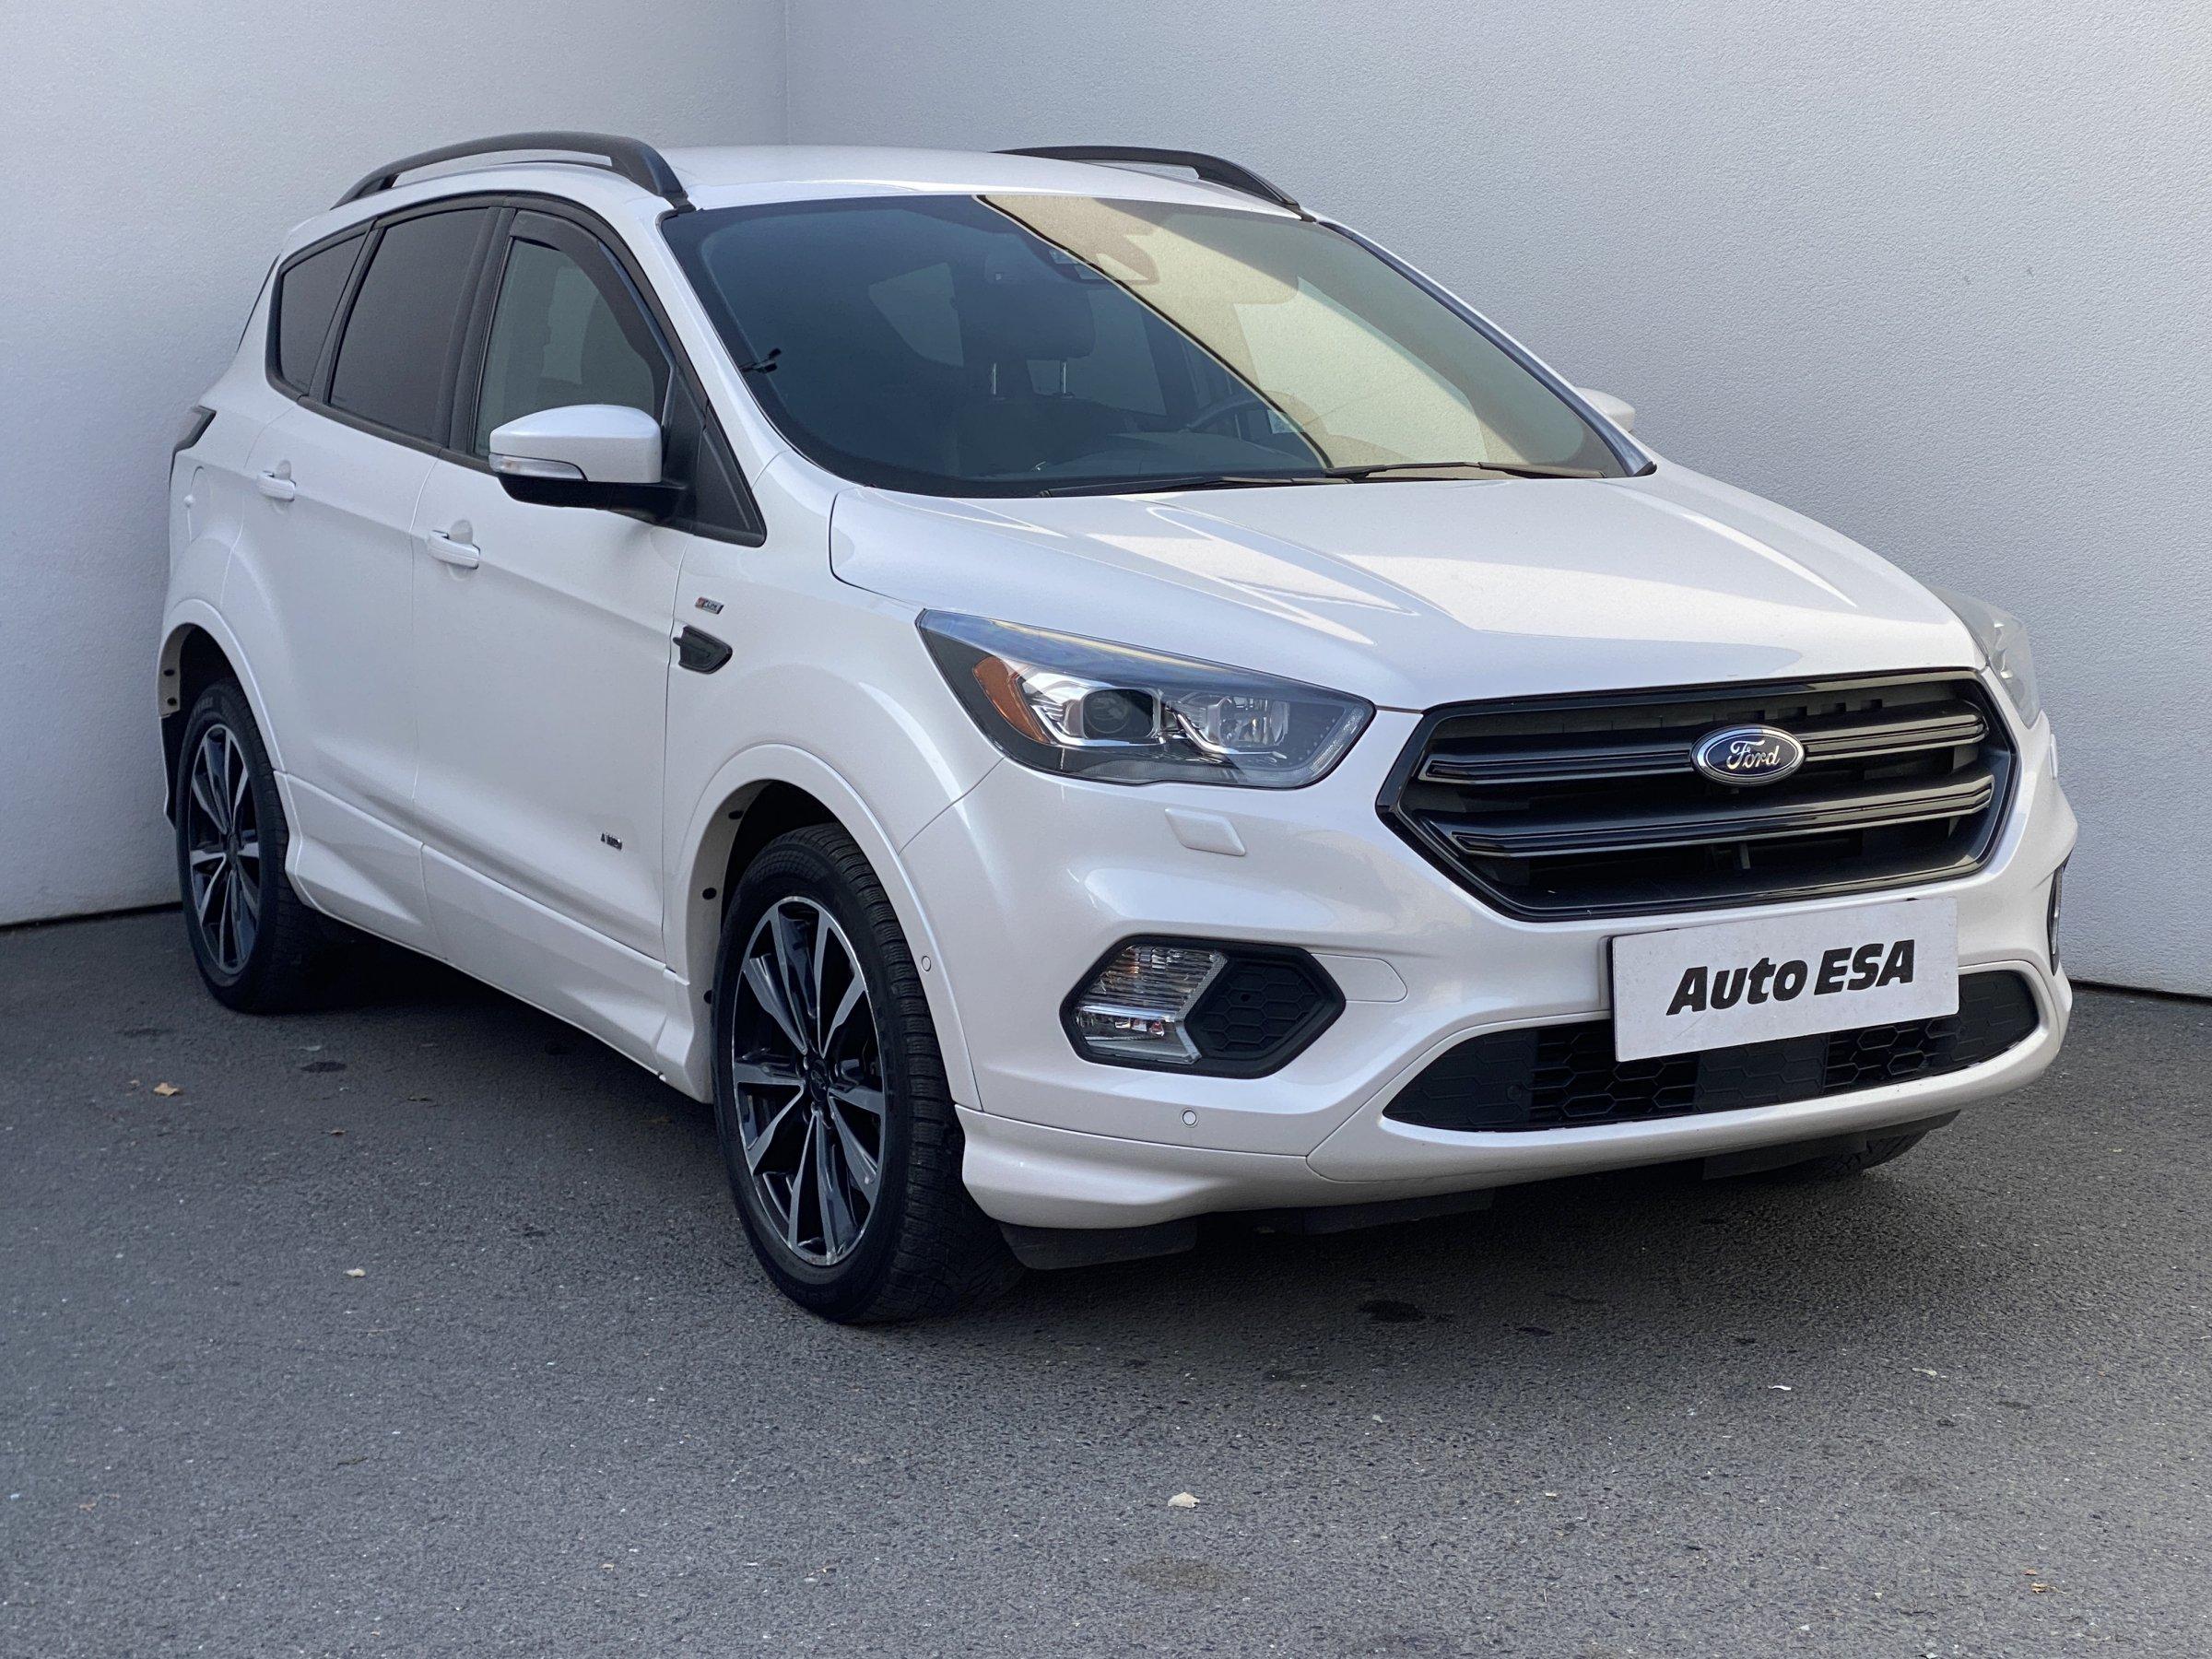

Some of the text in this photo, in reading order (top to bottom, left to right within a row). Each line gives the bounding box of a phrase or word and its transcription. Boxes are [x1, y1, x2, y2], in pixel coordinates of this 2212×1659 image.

[1726, 739, 1781, 770] Ford
[1665, 939, 1915, 1016] Auto ESA
